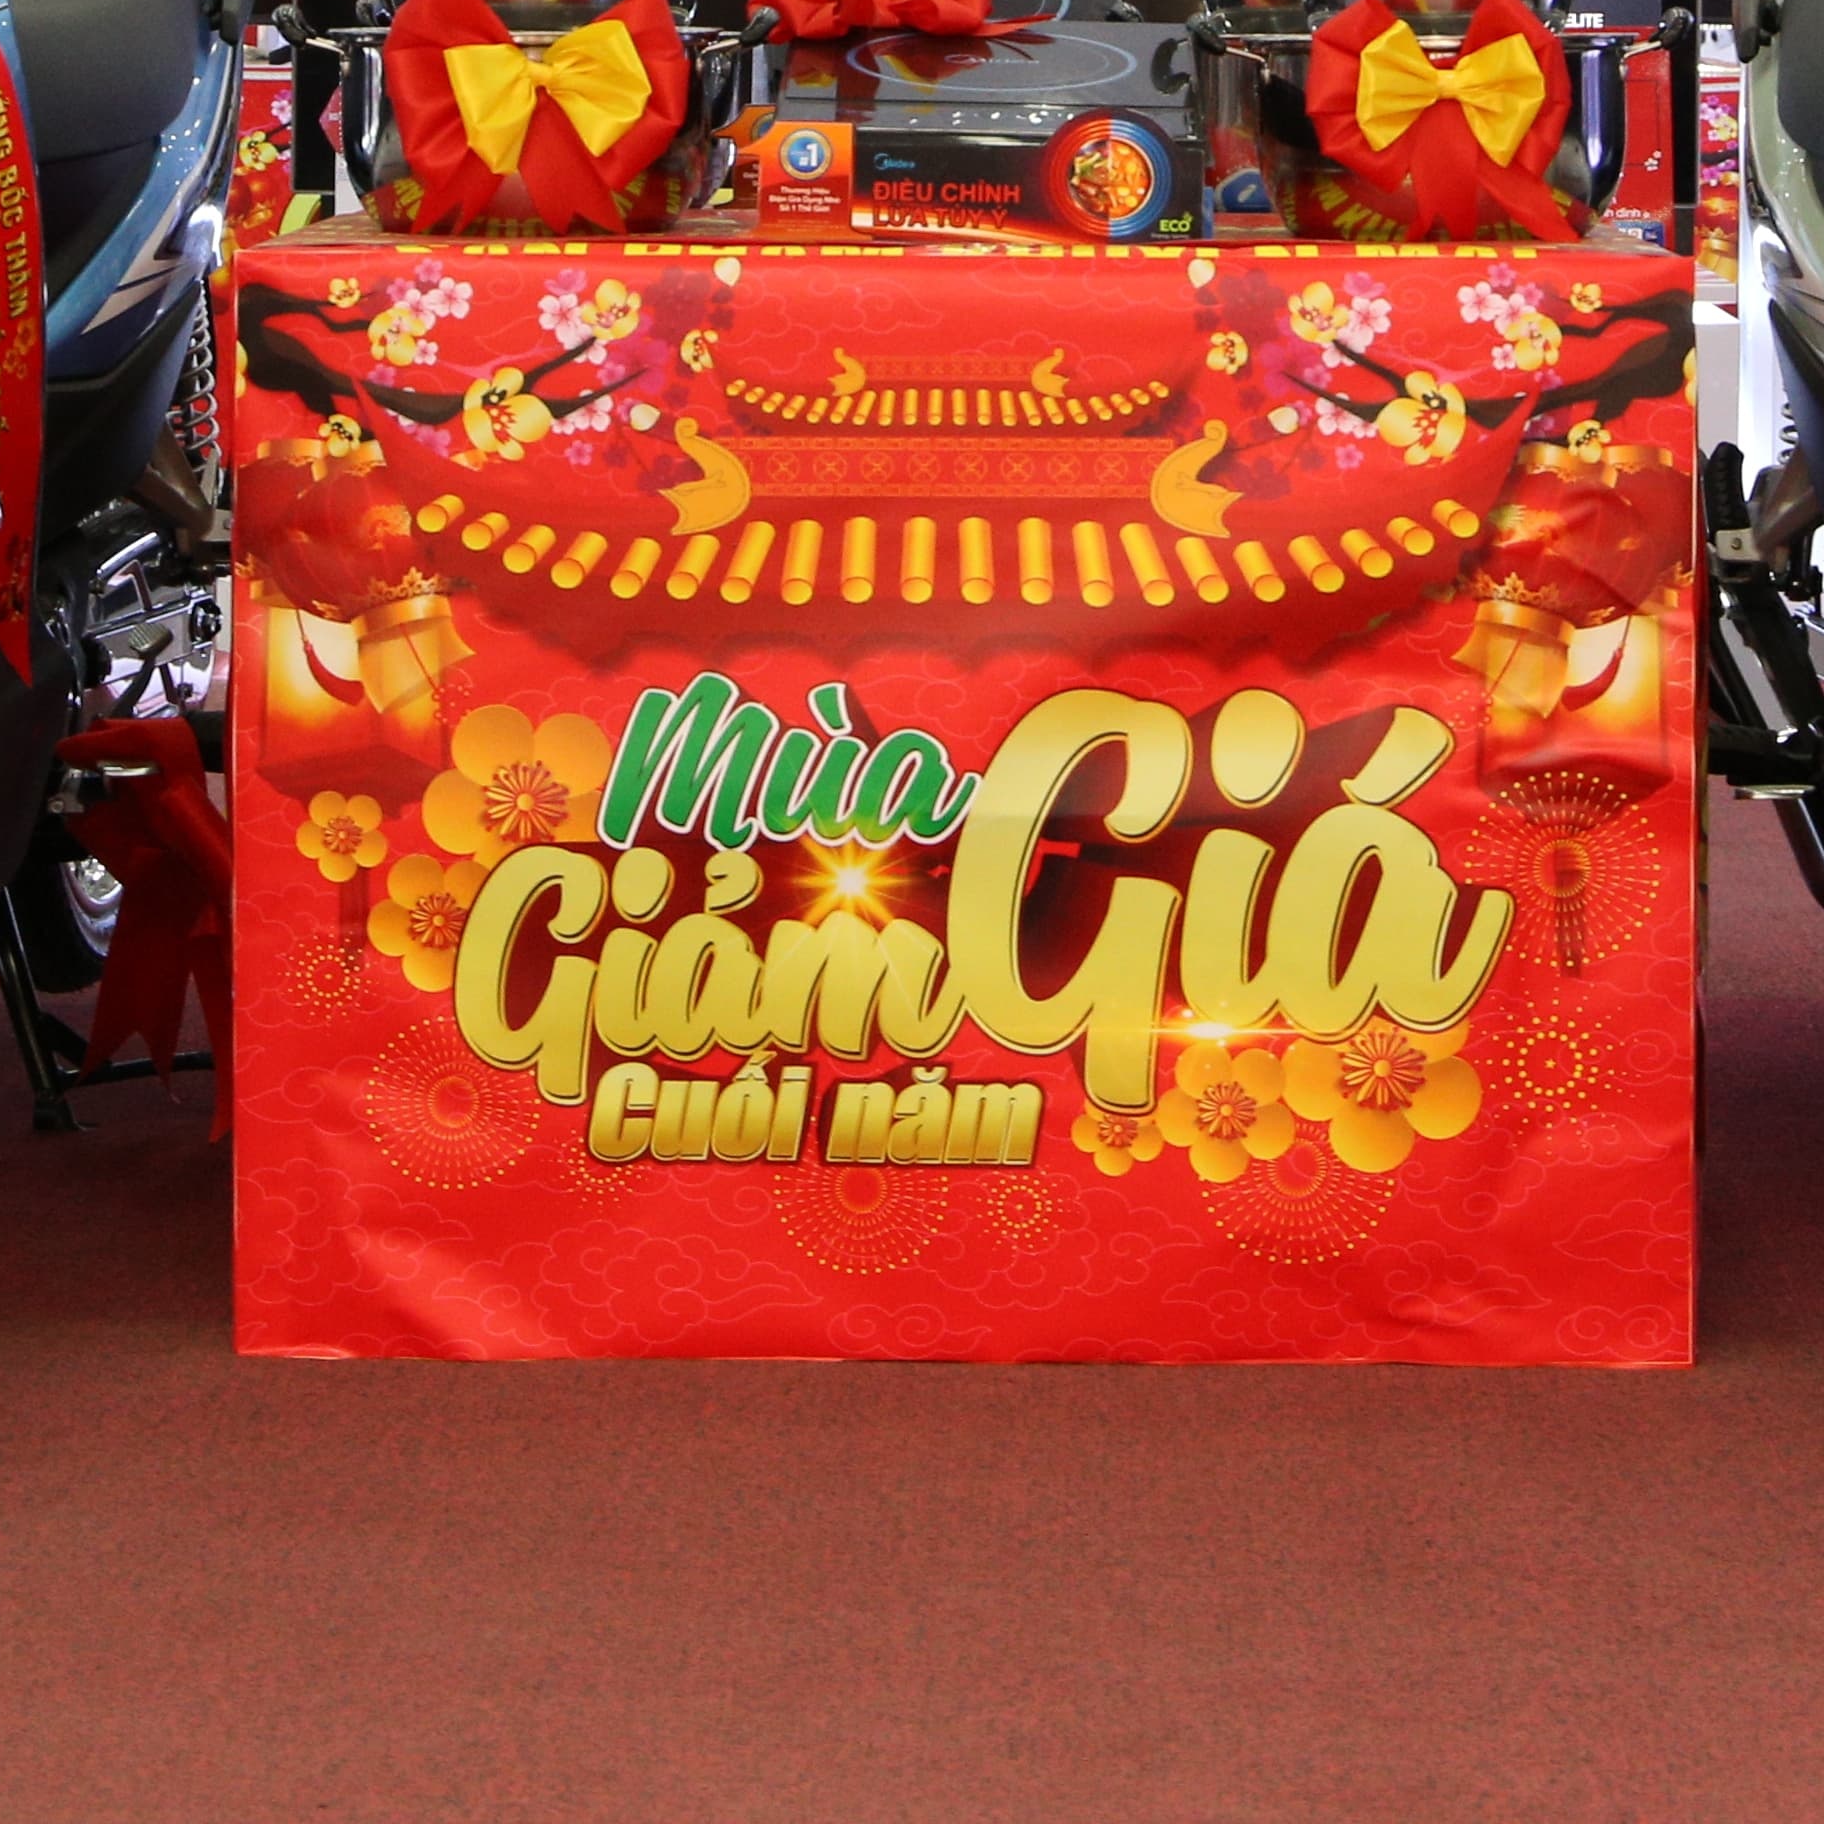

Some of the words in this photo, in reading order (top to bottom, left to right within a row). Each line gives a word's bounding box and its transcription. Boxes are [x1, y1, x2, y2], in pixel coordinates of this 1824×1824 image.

[872, 178, 934, 202] ĐIỀU
[1159, 218, 1190, 234] ECO
[2, 231, 35, 318] THĂM
[602, 671, 983, 852] Mùa
[945, 686, 1515, 1116] Giá
[454, 848, 978, 1108] Giảm
[588, 1056, 812, 1168] Cuối
[824, 1072, 1042, 1168] năm
